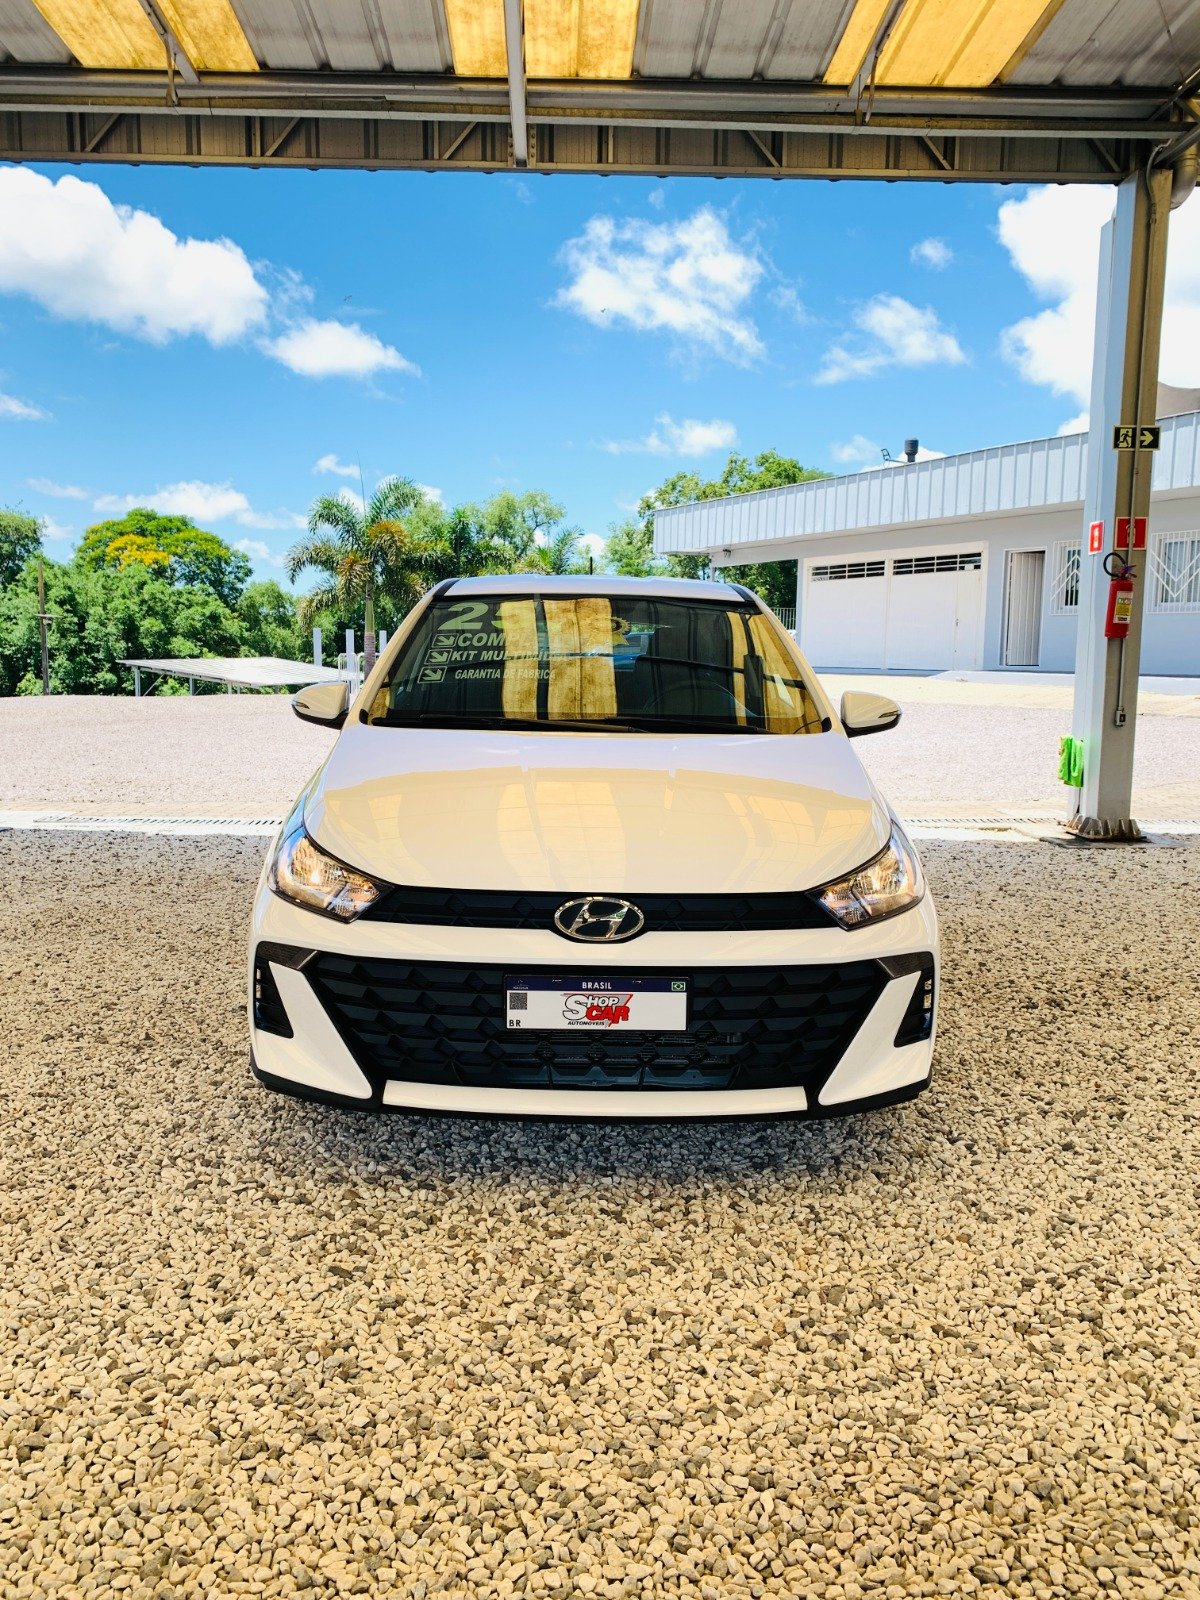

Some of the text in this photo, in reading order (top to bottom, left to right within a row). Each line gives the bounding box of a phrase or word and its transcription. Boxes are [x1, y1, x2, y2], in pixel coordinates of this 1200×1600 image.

[451, 650, 478, 661] KIT
[454, 668, 501, 680] GARANTIA
[503, 668, 517, 679] DE
[582, 981, 612, 990] BRASIL
[562, 994, 620, 1021] SHOP
[585, 1005, 631, 1024] CAR
[509, 1019, 522, 1028] BR
